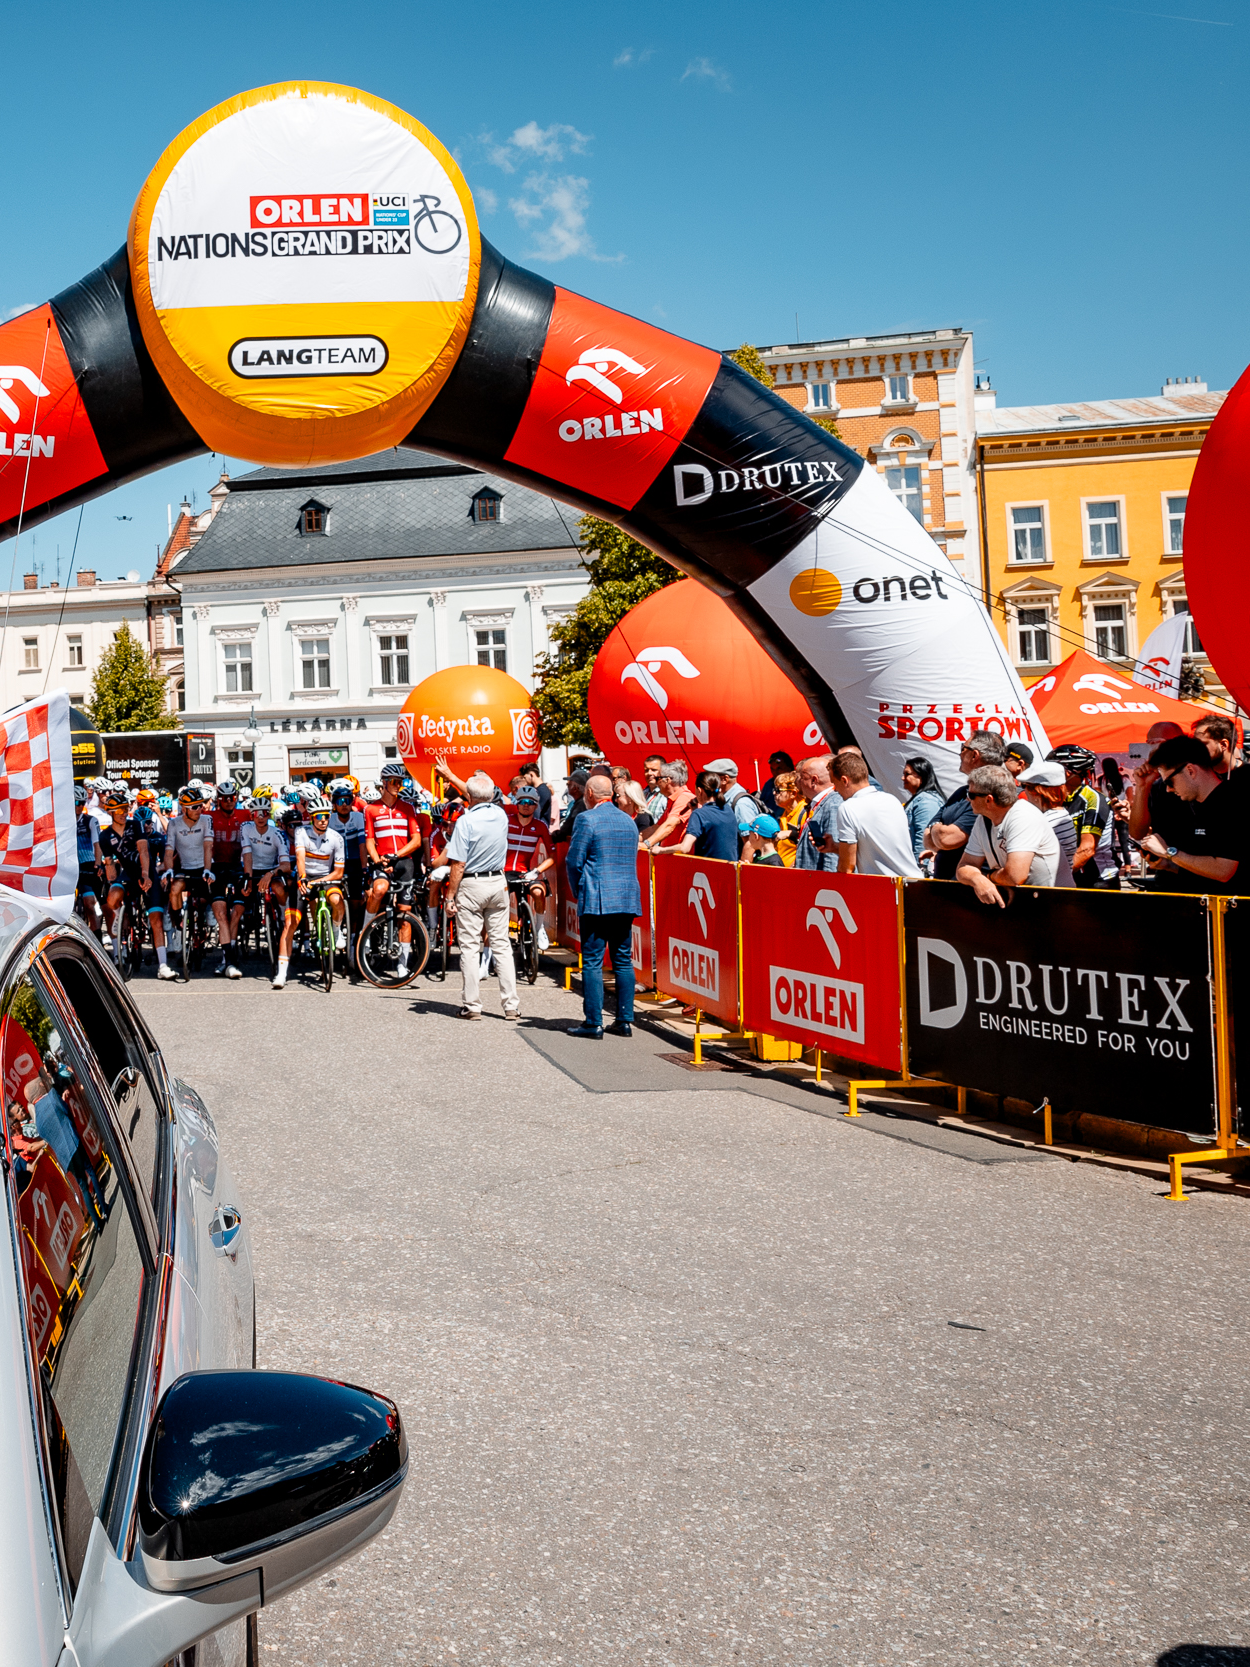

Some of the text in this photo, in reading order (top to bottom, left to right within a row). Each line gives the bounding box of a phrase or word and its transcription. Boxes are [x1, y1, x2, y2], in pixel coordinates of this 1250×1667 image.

[255, 198, 363, 224] ORLEN
[380, 197, 405, 206] UCI
[157, 230, 410, 261] NATIONS GRAND PRIX
[241, 347, 376, 367] LANGTEAM
[559, 407, 664, 443] ORLEN
[718, 461, 844, 494] DRUTEX
[853, 570, 949, 604] onet
[1145, 679, 1173, 691] RLEN
[1079, 702, 1161, 715] ORLEN
[270, 718, 367, 733] LÉKÁRNA
[418, 715, 494, 743] Jedynka
[615, 720, 709, 745] ORLEN
[877, 715, 1033, 742] SPORTOWY
[424, 745, 491, 755] POLSKIE RADIO
[106, 759, 159, 769] Official Sponsor
[193, 765, 213, 774] DRUTEX
[672, 944, 717, 993] ORLEN
[774, 976, 859, 1033] ORLEN
[974, 956, 1194, 1033] DRUTEX
[980, 1012, 1191, 1061] ENGINEERED FOR YOU
